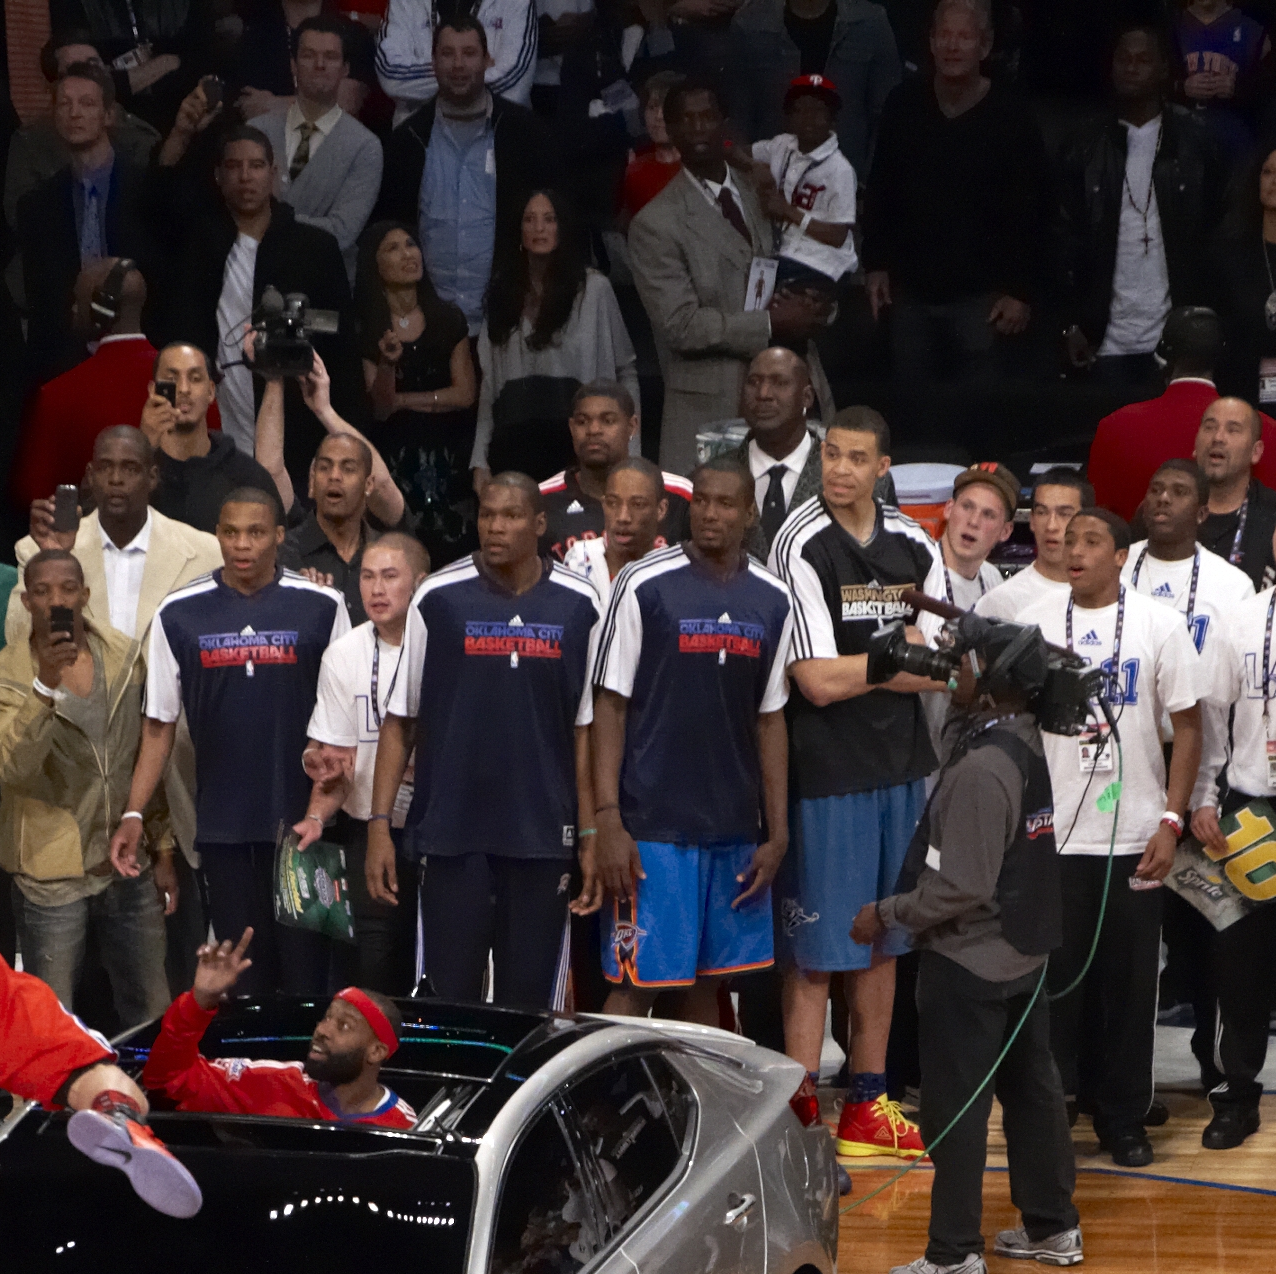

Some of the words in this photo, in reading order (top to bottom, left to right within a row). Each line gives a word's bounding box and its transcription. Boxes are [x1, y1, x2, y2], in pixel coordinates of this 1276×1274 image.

[841, 587, 905, 603] WASHINGTO
[465, 625, 535, 639] OKLAHOMA
[537, 628, 564, 641] CITY
[679, 622, 741, 638] OKLAHOMA
[743, 625, 765, 640] CITY
[199, 634, 269, 650] OKLAHOMA
[270, 633, 299, 647] CITY
[464, 637, 561, 654] BASKETBALL
[678, 634, 762, 653] BASKETBALL
[200, 645, 297, 663] BASKETBALL
[1176, 867, 1225, 903] Sprite
